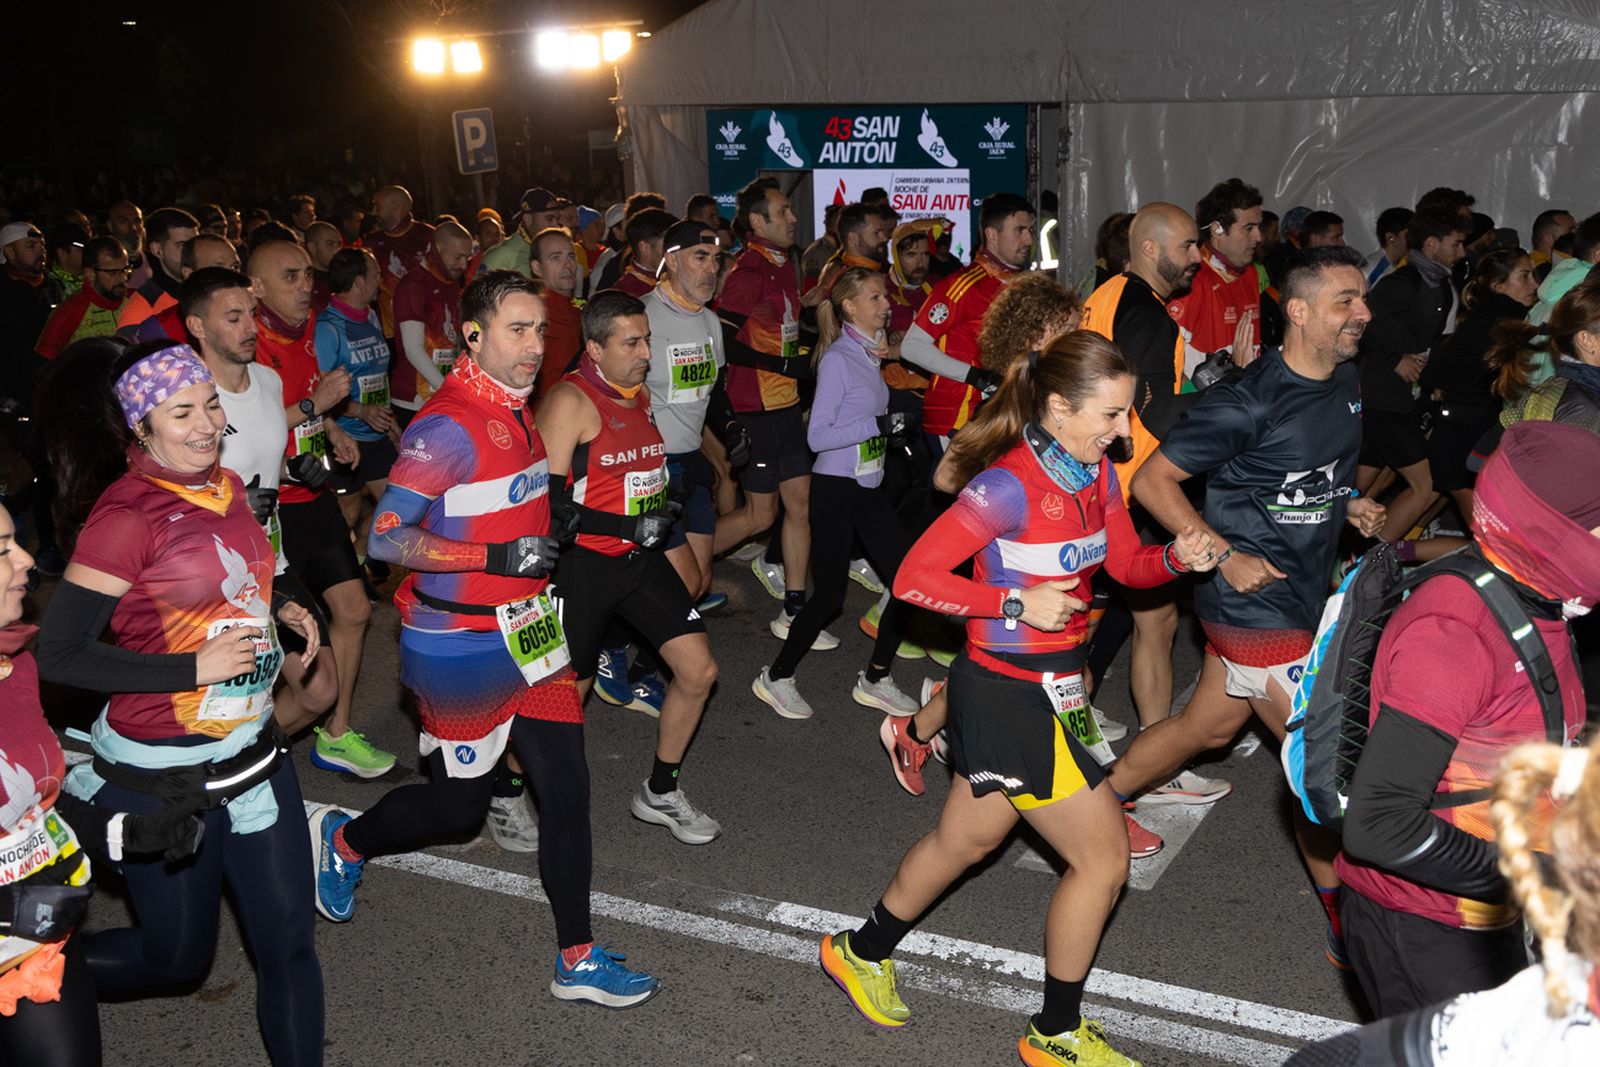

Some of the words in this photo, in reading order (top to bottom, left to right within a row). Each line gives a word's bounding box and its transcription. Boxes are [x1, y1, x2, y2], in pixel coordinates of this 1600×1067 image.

[463, 117, 487, 166] P
[777, 142, 792, 159] 43
[818, 135, 897, 163] ANTÓN
[929, 141, 945, 158] 43
[894, 185, 920, 194] NOCHE
[921, 185, 930, 193] DE
[892, 194, 929, 211] SAN
[681, 361, 711, 382] 4822
[600, 448, 637, 466] SAN
[633, 488, 648, 497] SAN
[1276, 512, 1312, 523] Juanjo
[517, 614, 557, 656] 6056
[19, 846, 51, 878] ANTÓN
[1045, 1040, 1079, 1065] HOKA
